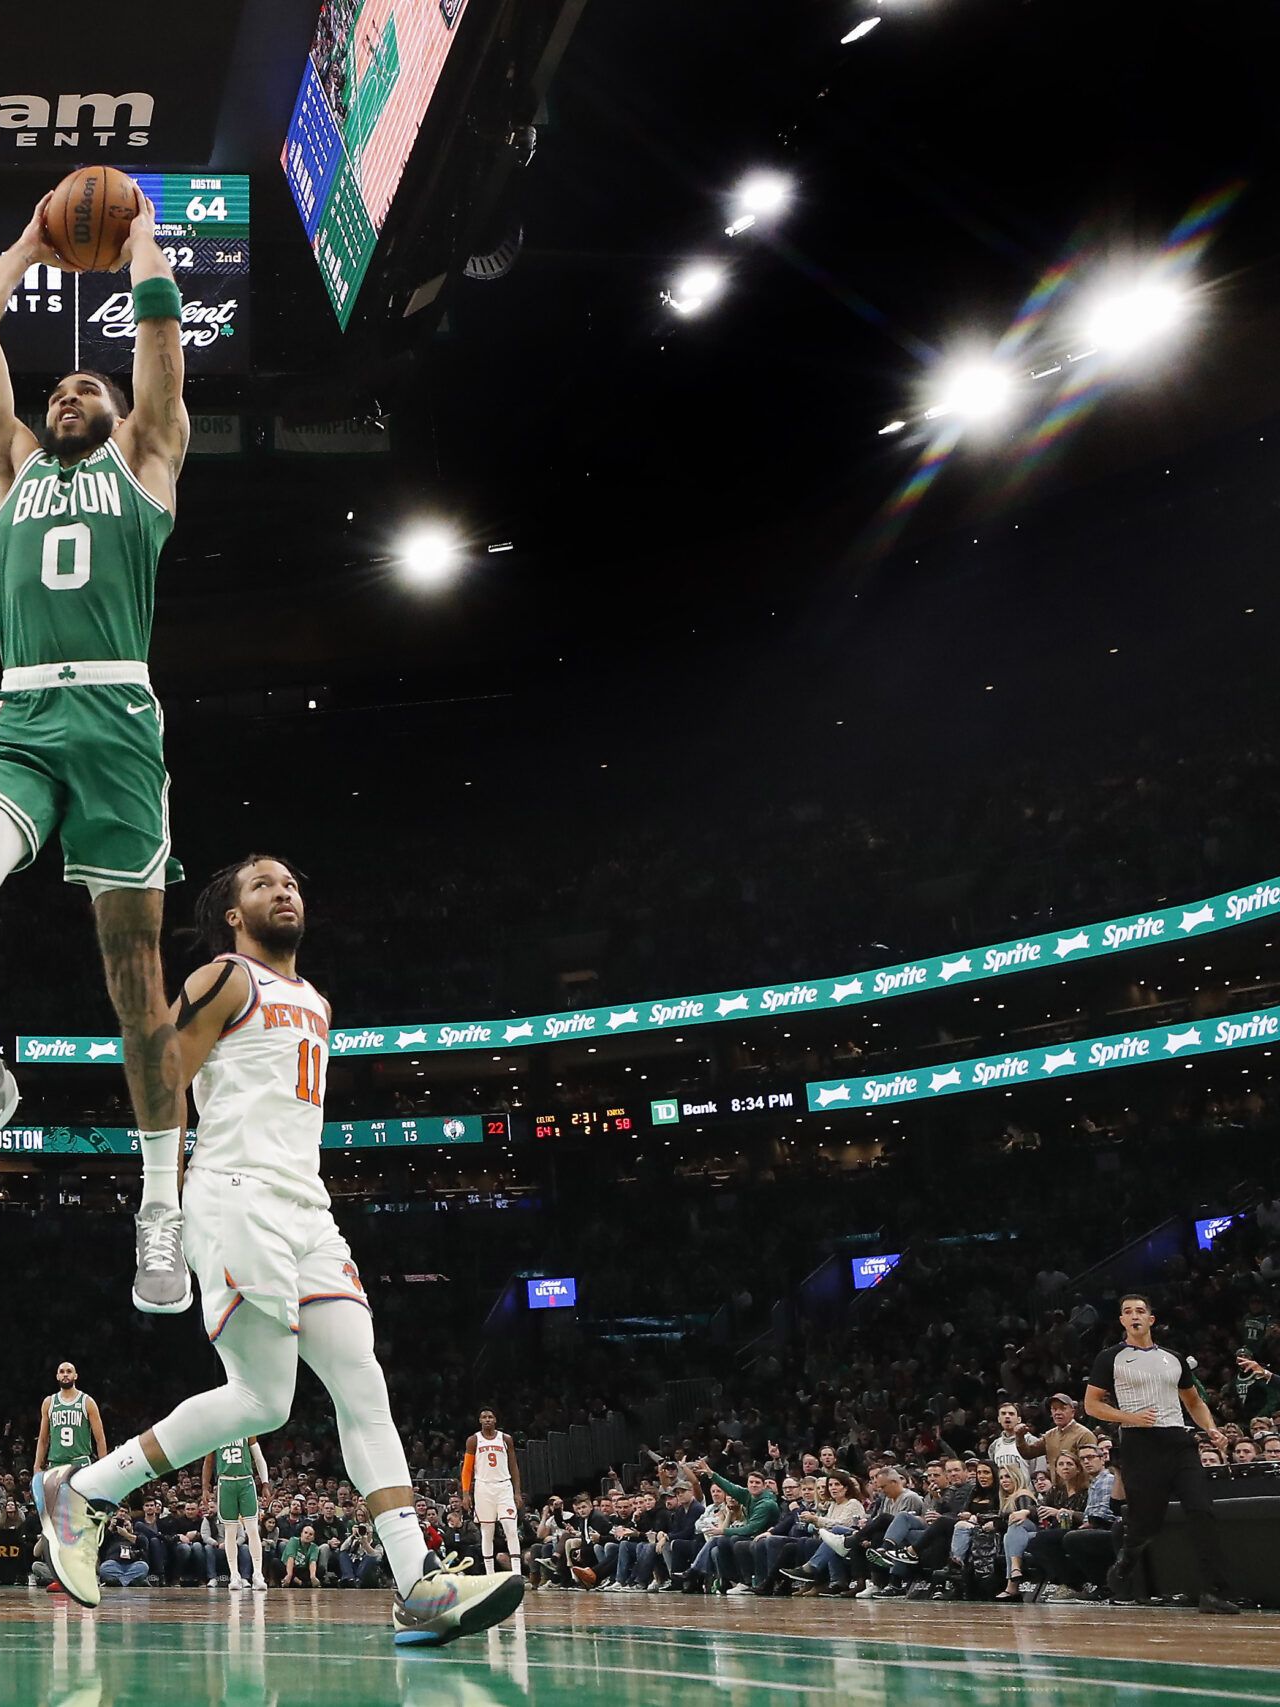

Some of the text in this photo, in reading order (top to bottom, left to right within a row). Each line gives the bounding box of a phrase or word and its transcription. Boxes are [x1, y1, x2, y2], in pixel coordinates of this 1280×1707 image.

[190, 179, 221, 189] BOSTON
[74, 176, 98, 245] Wilson
[186, 196, 228, 221] 64
[216, 251, 241, 263] 2nd
[12, 471, 122, 526] BOSTON
[41, 522, 91, 590] 0
[1224, 884, 1280, 920] Sprite
[1101, 916, 1165, 948] Sprite
[982, 942, 1042, 973] Sprite
[873, 965, 927, 994] Sprite
[760, 985, 818, 1012] Sprite
[260, 1004, 303, 1029] NEW
[649, 1000, 704, 1025] Sprite
[436, 1024, 491, 1046] Sprite
[544, 1013, 596, 1038] Sprite
[1214, 1014, 1279, 1046] Sprite
[24, 1040, 76, 1060] Sprite
[332, 1030, 384, 1052] Sprite
[1088, 1037, 1150, 1066] Sprite
[295, 1038, 321, 1108] 11
[972, 1056, 1030, 1085] Sprite
[862, 1076, 918, 1102] Sprite
[682, 1100, 718, 1116] Bank
[731, 1096, 765, 1112] 8:34
[768, 1092, 794, 1108] PM
[371, 1122, 386, 1130] AST
[401, 1121, 416, 1129] REB
[536, 1127, 552, 1138] 64
[616, 1118, 631, 1130] 58
[572, 1112, 597, 1124] 2:31
[130, 1140, 138, 1150] 5
[345, 1123, 504, 1145] 2 11 15 22
[536, 1286, 568, 1296] ULTRA
[52, 1409, 82, 1428] BOSTON
[60, 1427, 74, 1446] 9
[222, 1448, 242, 1464] 42
[488, 1452, 497, 1468] 9
